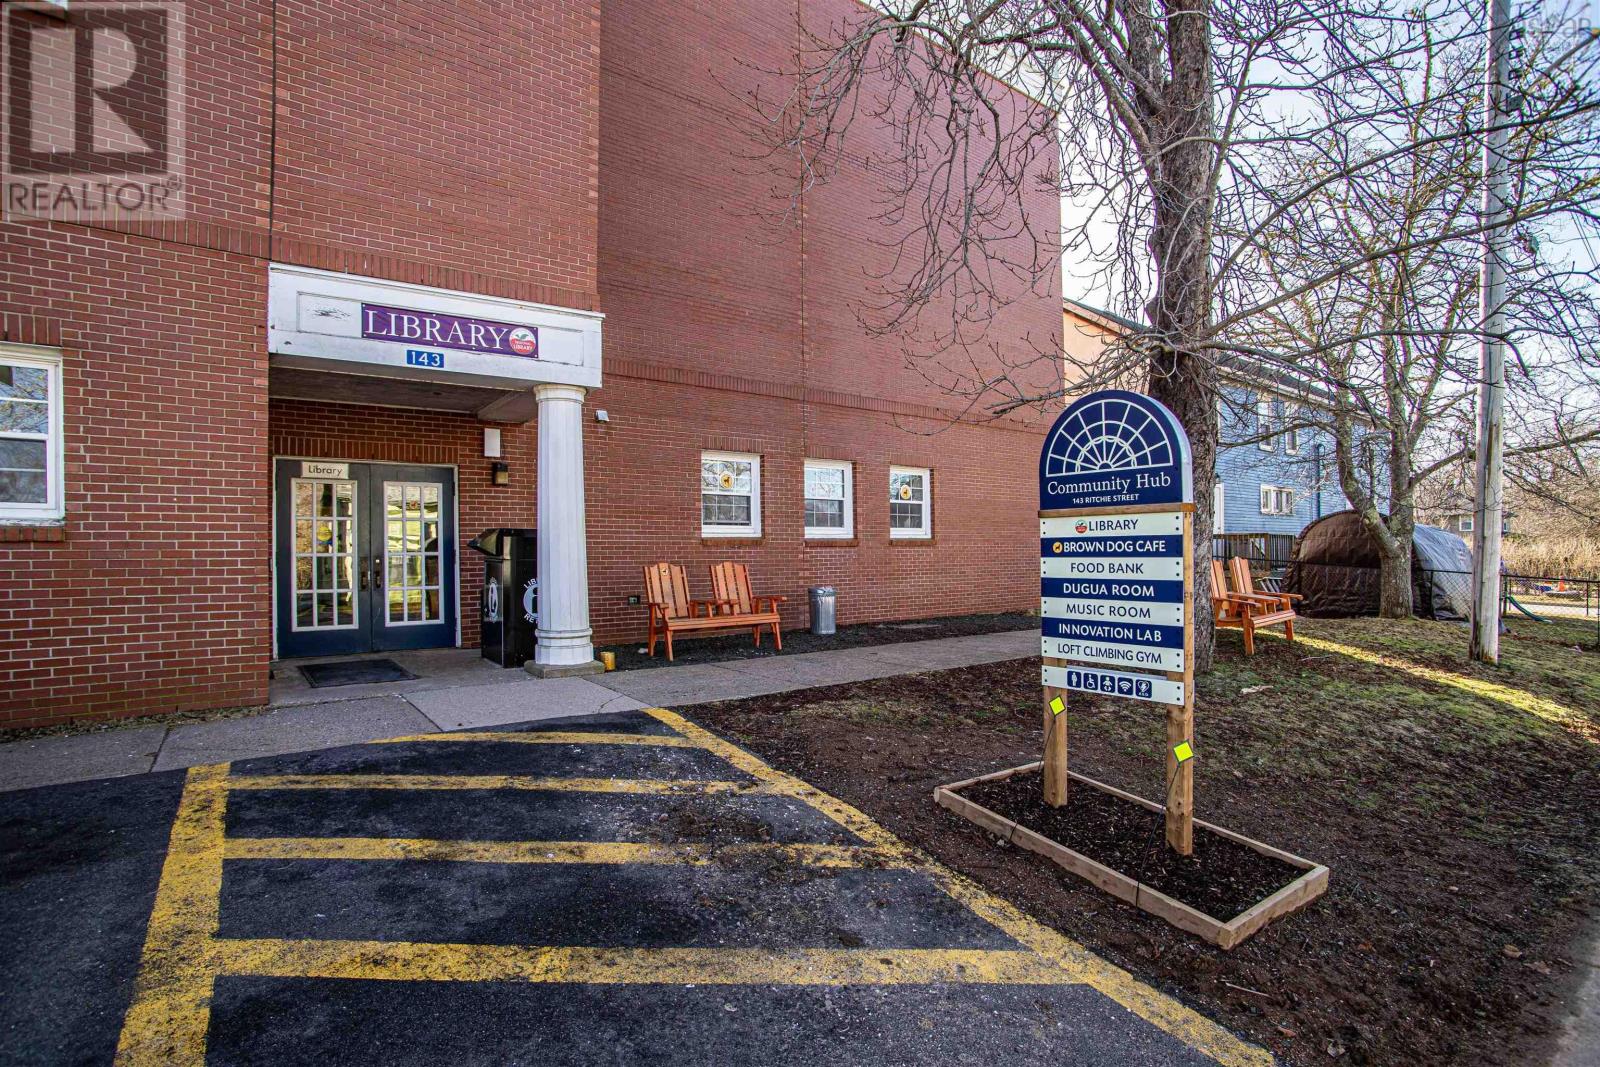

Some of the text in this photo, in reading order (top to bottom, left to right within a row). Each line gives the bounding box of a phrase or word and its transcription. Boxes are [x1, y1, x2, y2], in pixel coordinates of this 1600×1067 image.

[365, 309, 509, 349] LIBRARY
[412, 351, 440, 367] 143
[308, 464, 343, 476] Library
[1047, 472, 1171, 494] Community Hub
[1085, 495, 1112, 503] RITCHIE
[1113, 494, 1140, 502] STREET
[1088, 519, 1139, 531] LIBRARY
[1063, 540, 1166, 552] BROWN DOG CAFE
[1070, 562, 1144, 574] FOOD BANK
[1063, 583, 1155, 597] DUGUA ROOM
[1066, 604, 1151, 618] MUSIC ROOM
[1058, 623, 1162, 642] INNOVATION LAB
[1057, 643, 1162, 664] LOFT CLIMBING GYM
